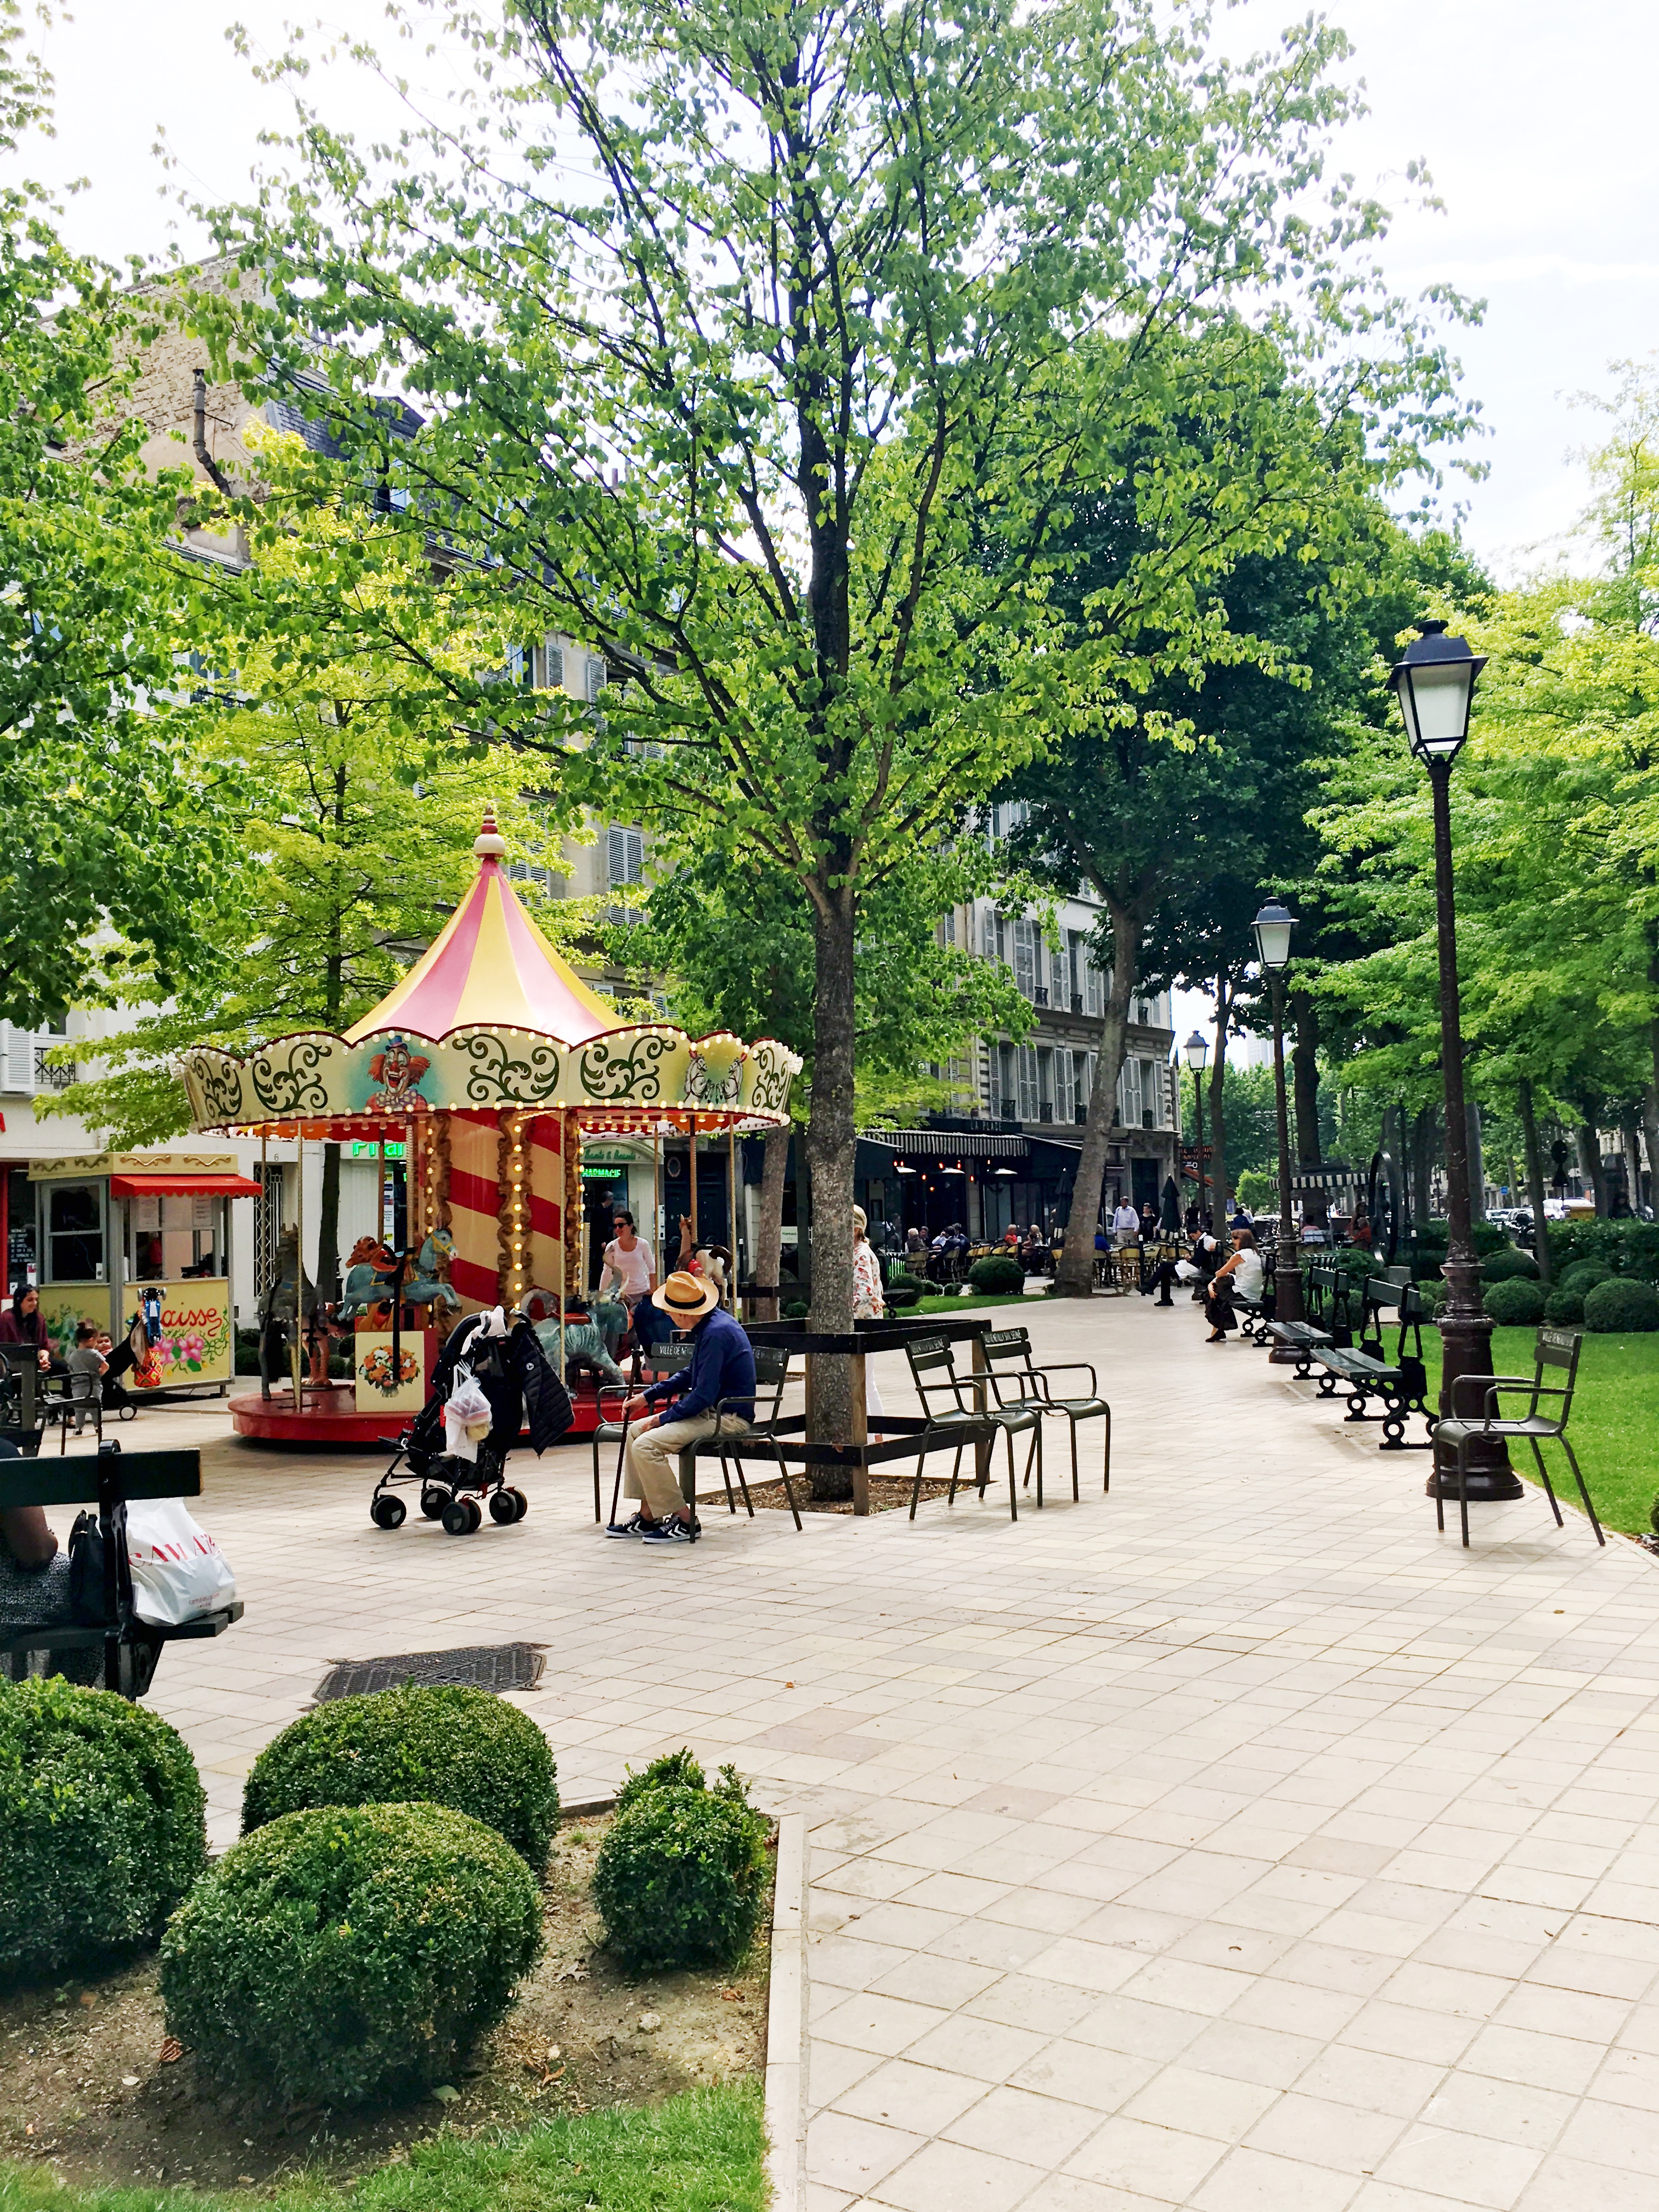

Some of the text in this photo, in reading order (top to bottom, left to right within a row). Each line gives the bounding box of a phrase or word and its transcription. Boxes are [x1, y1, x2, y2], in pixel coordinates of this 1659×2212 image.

[970, 1120, 1002, 1131] LA PLACE
[274, 1153, 279, 1162] 6
[161, 1308, 222, 1336] aisse
[659, 1346, 673, 1356] VILLE
[674, 1346, 680, 1356] DE
